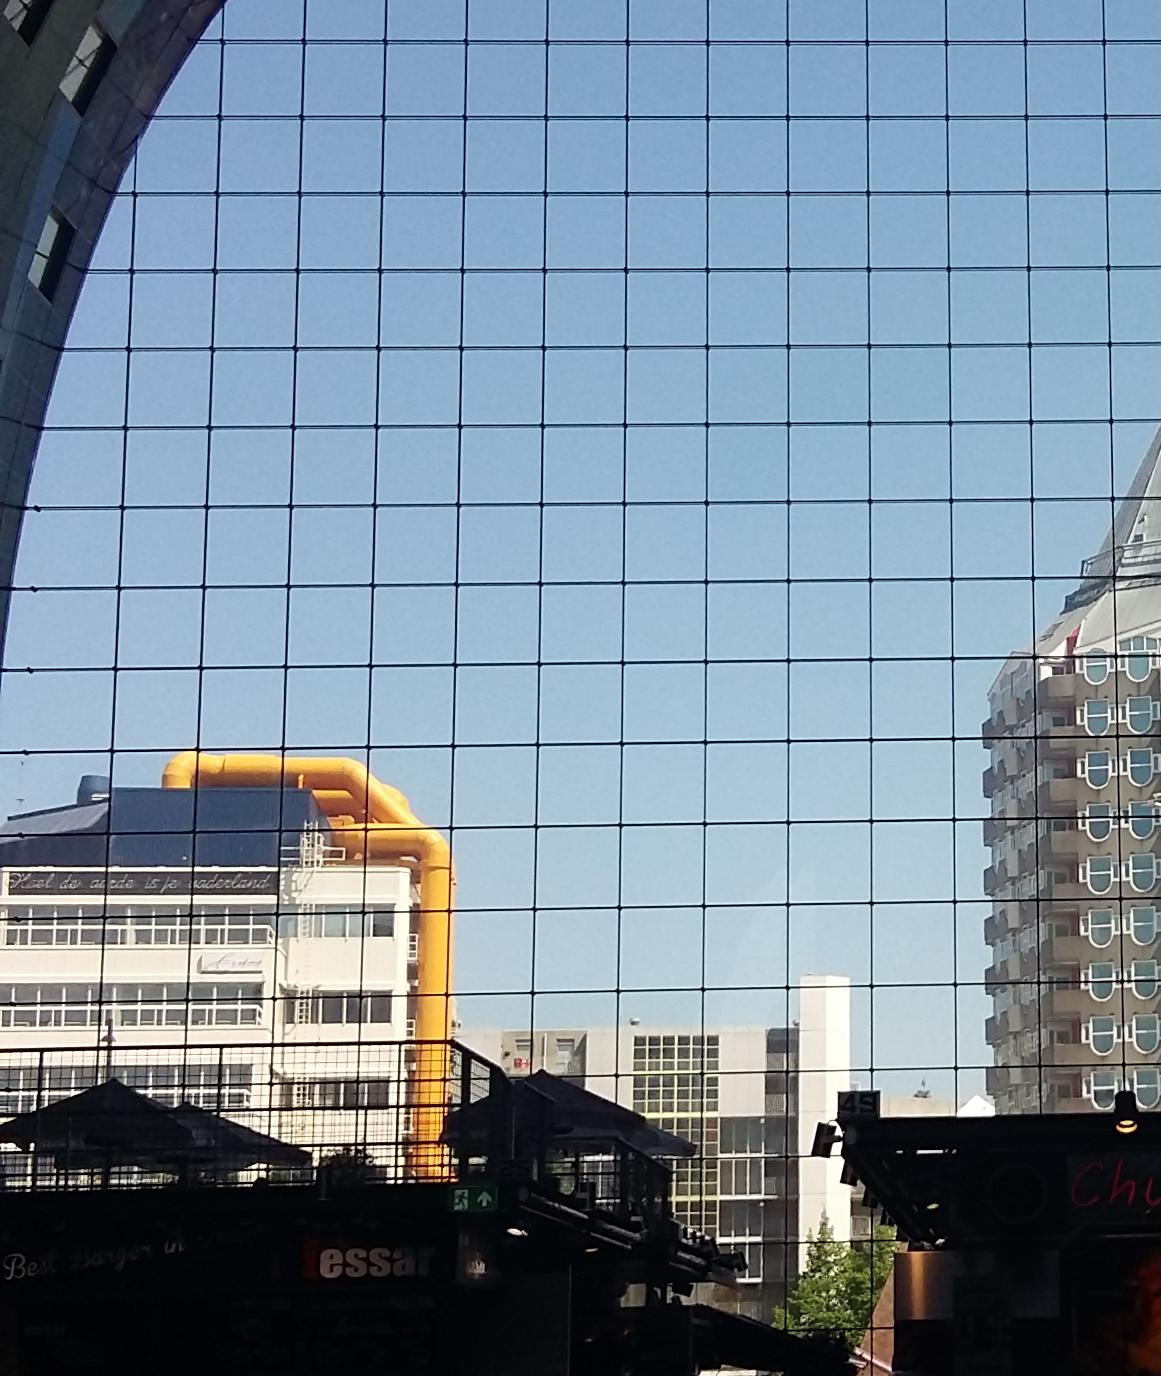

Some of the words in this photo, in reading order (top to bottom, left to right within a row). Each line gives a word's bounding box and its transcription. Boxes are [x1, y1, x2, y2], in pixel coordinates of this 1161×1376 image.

[59, 873, 81, 889] de
[89, 873, 136, 889] aarde
[144, 876, 160, 889] is
[160, 876, 178, 894] je
[188, 873, 270, 889] vaderland
